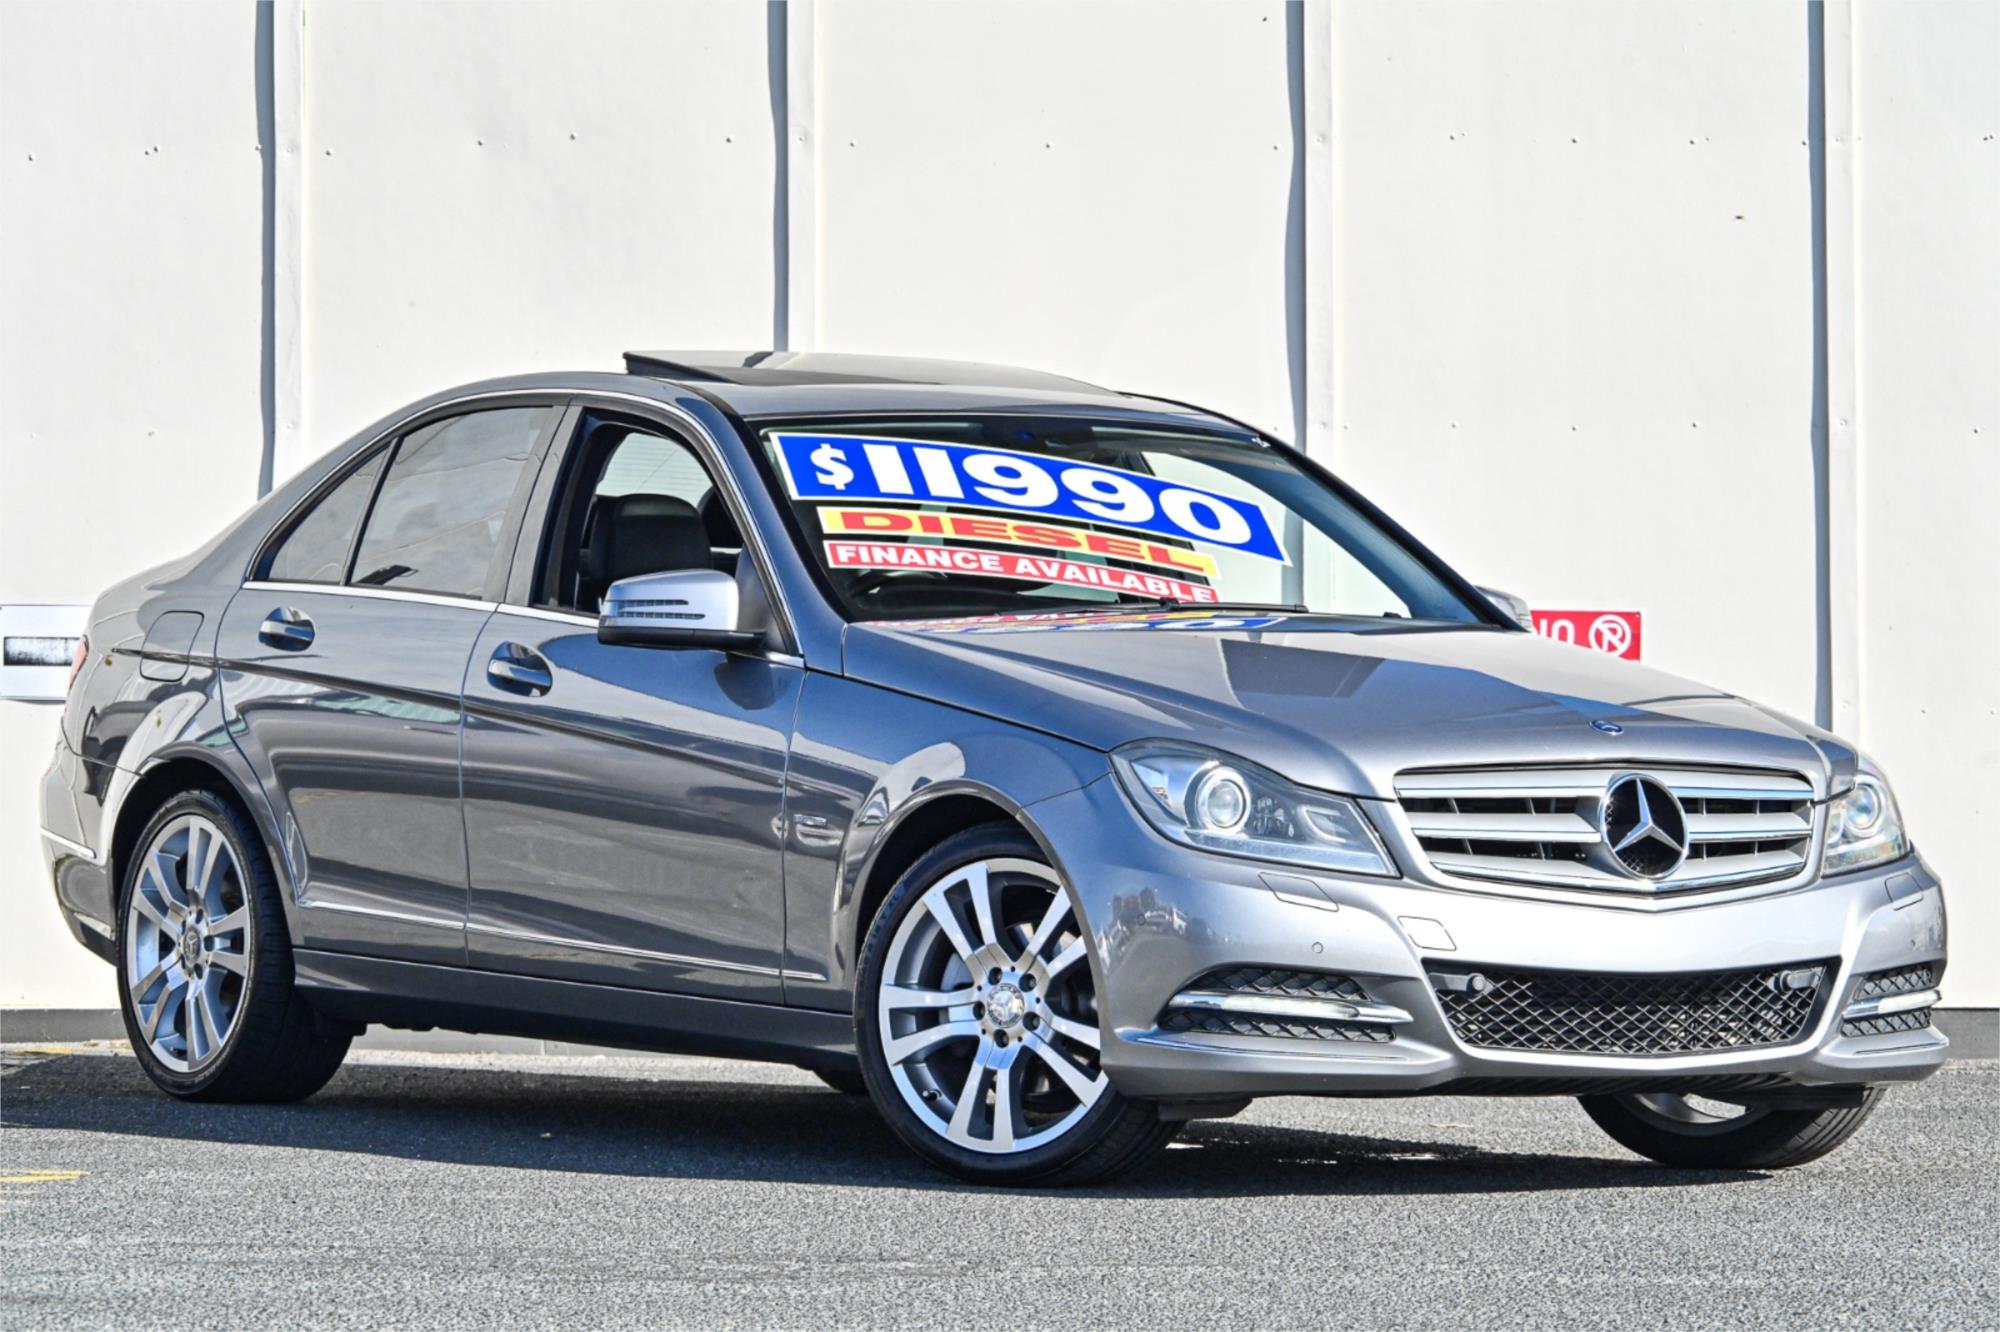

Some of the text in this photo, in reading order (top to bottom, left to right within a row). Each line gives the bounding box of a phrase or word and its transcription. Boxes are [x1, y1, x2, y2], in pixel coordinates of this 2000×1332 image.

[809, 443, 1252, 545] $11990
[840, 511, 1205, 573] DIESEL
[835, 545, 1213, 603] FINANCE AVAILABLE
